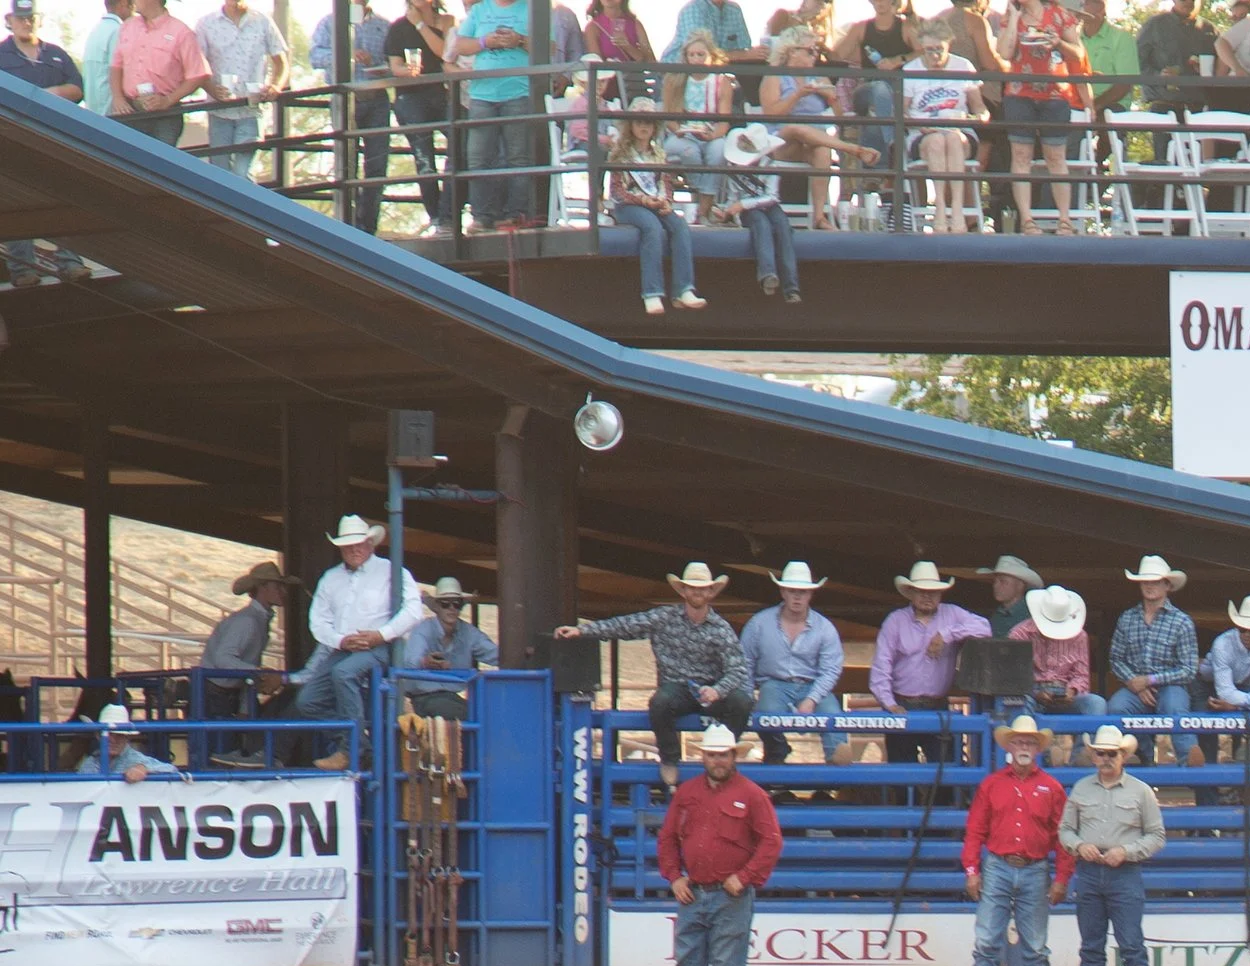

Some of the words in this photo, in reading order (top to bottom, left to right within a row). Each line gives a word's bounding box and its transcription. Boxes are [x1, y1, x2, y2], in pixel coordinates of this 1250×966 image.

[759, 716, 828, 727] COWBOY
[834, 716, 907, 729] REUNION
[1121, 717, 1174, 729] TEXAS
[1179, 717, 1246, 729] COWBOY
[573, 726, 587, 804] W-W
[89, 800, 339, 862] ANSON
[78, 872, 249, 898] Lawrence
[257, 868, 338, 893] Hall
[573, 813, 588, 944] RODEO
[226, 918, 283, 935] GMC
